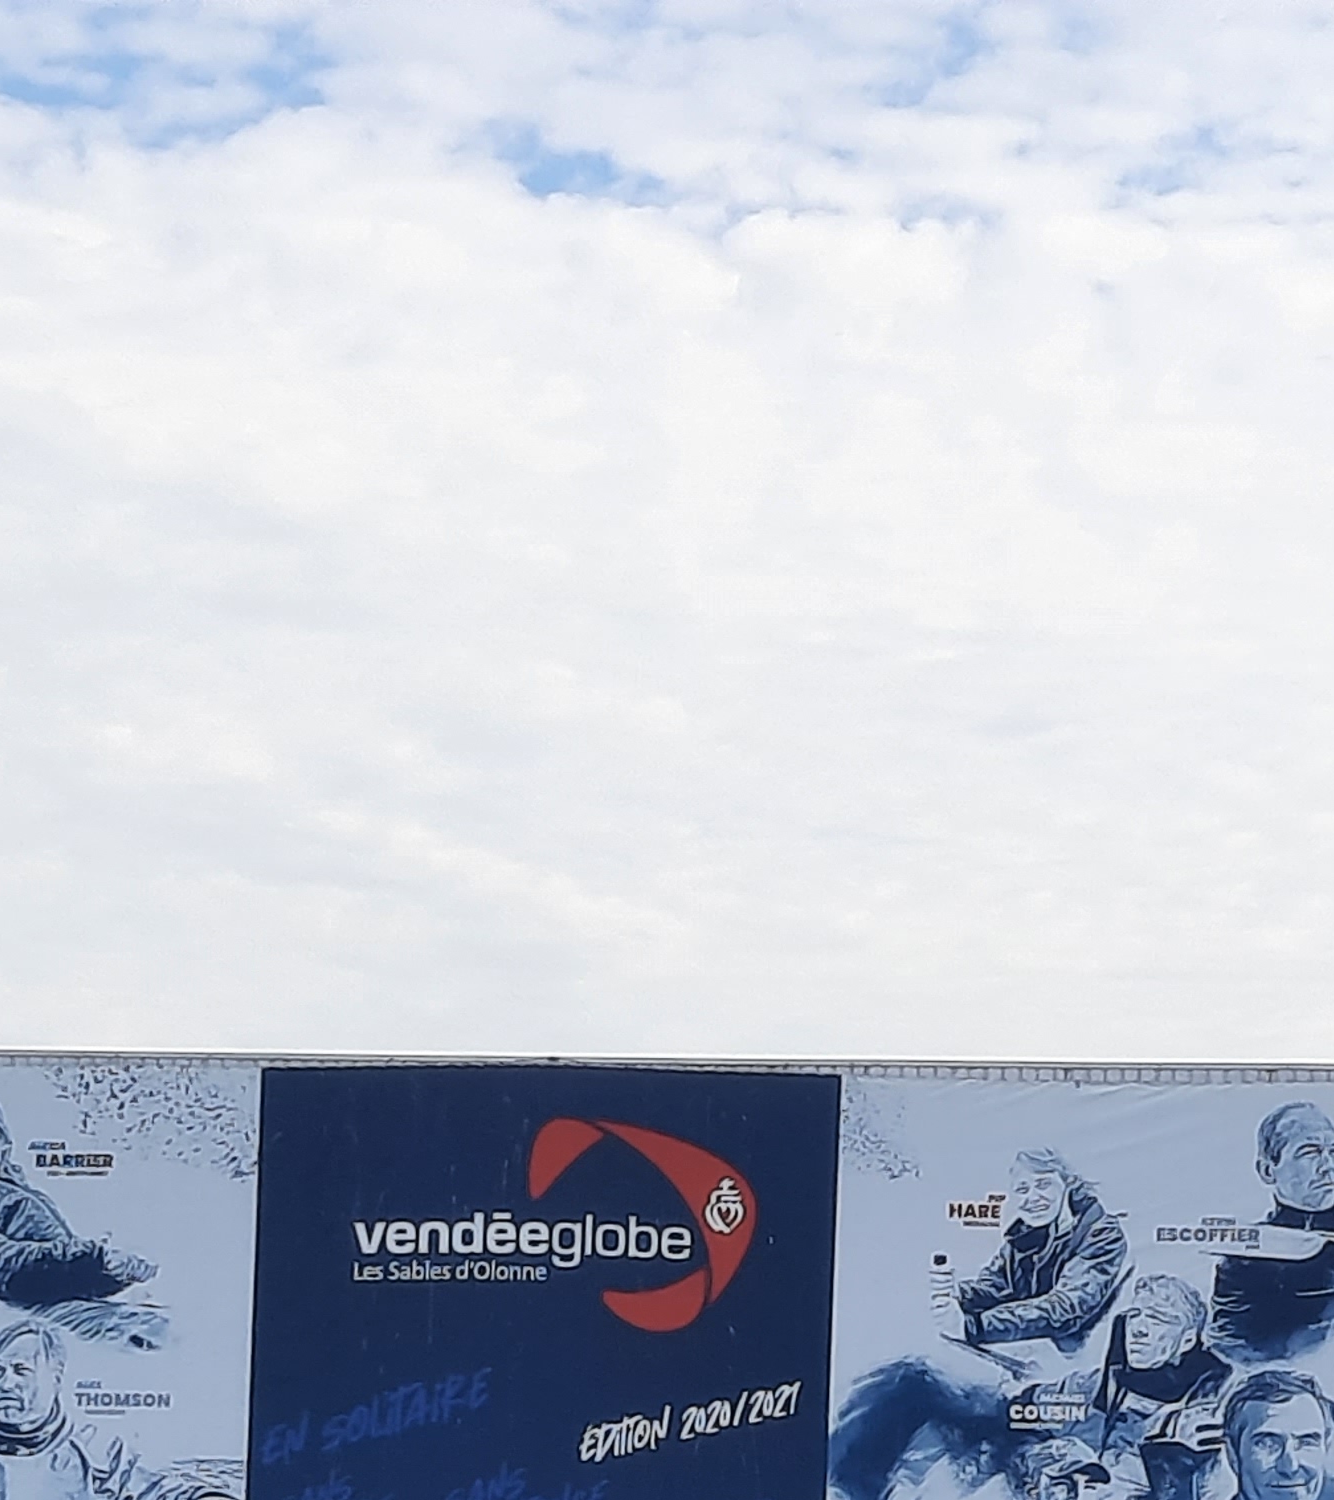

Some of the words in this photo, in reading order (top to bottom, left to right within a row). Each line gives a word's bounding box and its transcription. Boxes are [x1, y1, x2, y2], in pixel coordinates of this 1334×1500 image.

[949, 1203, 1001, 1219] HARE
[1156, 1227, 1260, 1243] ESCOFFIER
[353, 1261, 384, 1282] Les
[387, 1260, 451, 1282] Sables
[455, 1259, 548, 1282] d'Olonne
[75, 1392, 171, 1408] THOMSON
[261, 1410, 311, 1465] EN
[321, 1367, 492, 1451] SOLITAIRE
[1009, 1404, 1087, 1422] COUSIN
